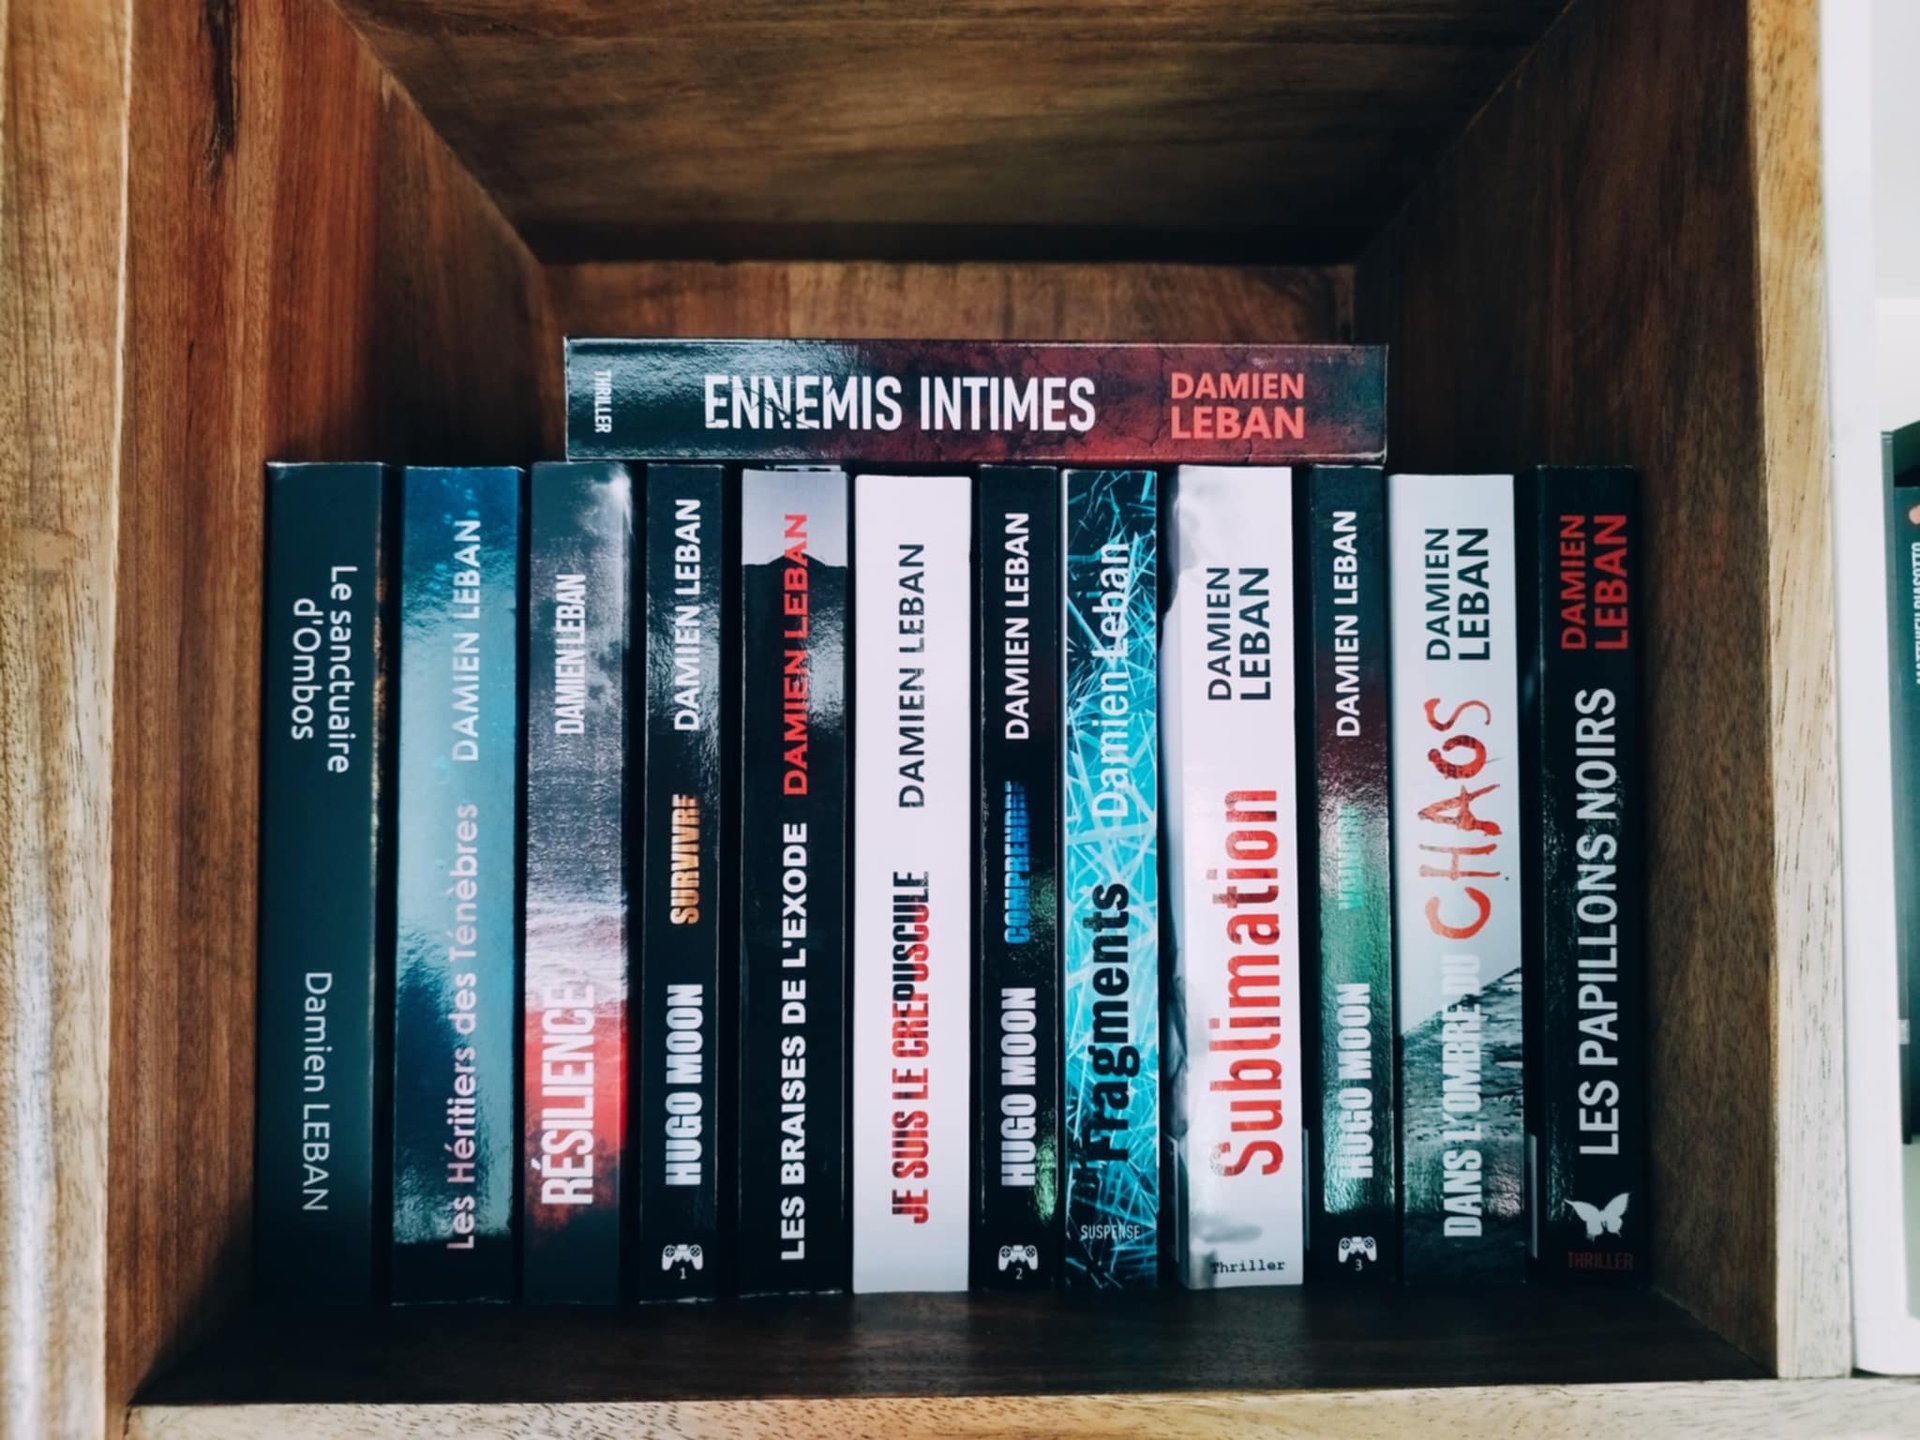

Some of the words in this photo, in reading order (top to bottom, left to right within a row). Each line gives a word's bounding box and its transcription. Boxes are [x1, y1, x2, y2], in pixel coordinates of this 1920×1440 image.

[594, 370, 612, 434] THRILLER
[704, 374, 903, 431] ENNEMIS
[920, 375, 1096, 432] INTIMES
[1170, 372, 1305, 400] DAMIEN
[1170, 405, 1305, 441] LEBAN
[329, 565, 358, 601] Le
[453, 519, 482, 620] LEBAN
[674, 499, 701, 596] LEBAN
[784, 513, 808, 639] LEBAN
[898, 543, 926, 654] LEBAN
[1004, 512, 1030, 608] LEBAN
[1332, 510, 1359, 605] LEBAN
[1424, 527, 1451, 661] DAMIEN
[1456, 527, 1491, 661] LEBAN
[1560, 514, 1587, 650] DAMIEN
[1593, 514, 1629, 650] LEBAN
[555, 573, 587, 646] LEBAN
[1091, 542, 1131, 659] Leban
[1205, 567, 1232, 701] DAMIEN
[1238, 567, 1272, 701] LEBAN
[291, 598, 324, 741] d'Ombos
[327, 610, 357, 774] sanctuaire
[452, 631, 480, 762] DAMIEN
[554, 644, 586, 735] DAMIEN
[674, 605, 701, 731] DAMIEN
[1004, 617, 1030, 740] DAMIEN
[1333, 614, 1361, 737] DAMIEN
[784, 649, 808, 796] DAMIEN
[898, 667, 926, 809] DAMIEN
[1091, 670, 1130, 818] Damien
[1574, 688, 1618, 821] NOIRS
[1417, 697, 1503, 940] CHAOS
[446, 803, 478, 962] Ténèbres
[782, 821, 808, 968] L'EXODE
[892, 870, 930, 1059] CREPUSCULE
[1206, 789, 1285, 1177] Sublimation
[1440, 953, 1481, 1000] DU
[1576, 833, 1620, 1067] PAPILLONS
[303, 972, 333, 1094] Damien
[448, 973, 477, 1036] des
[665, 983, 704, 1085] MOON
[781, 979, 807, 1025] DE
[1000, 986, 1038, 1086] MOON
[1084, 882, 1141, 1163] Fragments
[1336, 982, 1373, 1082] MOON
[445, 1045, 477, 1184] Héritiers
[531, 984, 595, 1205] RÉSILIENCE
[780, 1035, 807, 1185] BRAISES
[891, 1067, 930, 1101] LE
[1442, 1003, 1483, 1141] L'OMBRE
[1578, 1080, 1620, 1156] LES
[301, 1103, 331, 1211] LEBAN
[665, 1092, 704, 1186] HUGO
[891, 1110, 930, 1180] SUIS
[1000, 1093, 1038, 1187] HUGO
[1337, 1087, 1374, 1180] HUGO
[446, 1196, 475, 1250] Les
[780, 1196, 806, 1261] LES
[891, 1188, 930, 1225] JE
[1080, 1224, 1142, 1240] SUSPENSE
[1443, 1149, 1483, 1238] DANS
[679, 1266, 688, 1281] 1
[1015, 1267, 1024, 1281] 2
[1210, 1259, 1286, 1275] Thriller
[1354, 1259, 1363, 1272] 3
[1567, 1251, 1634, 1270] THRILLER
